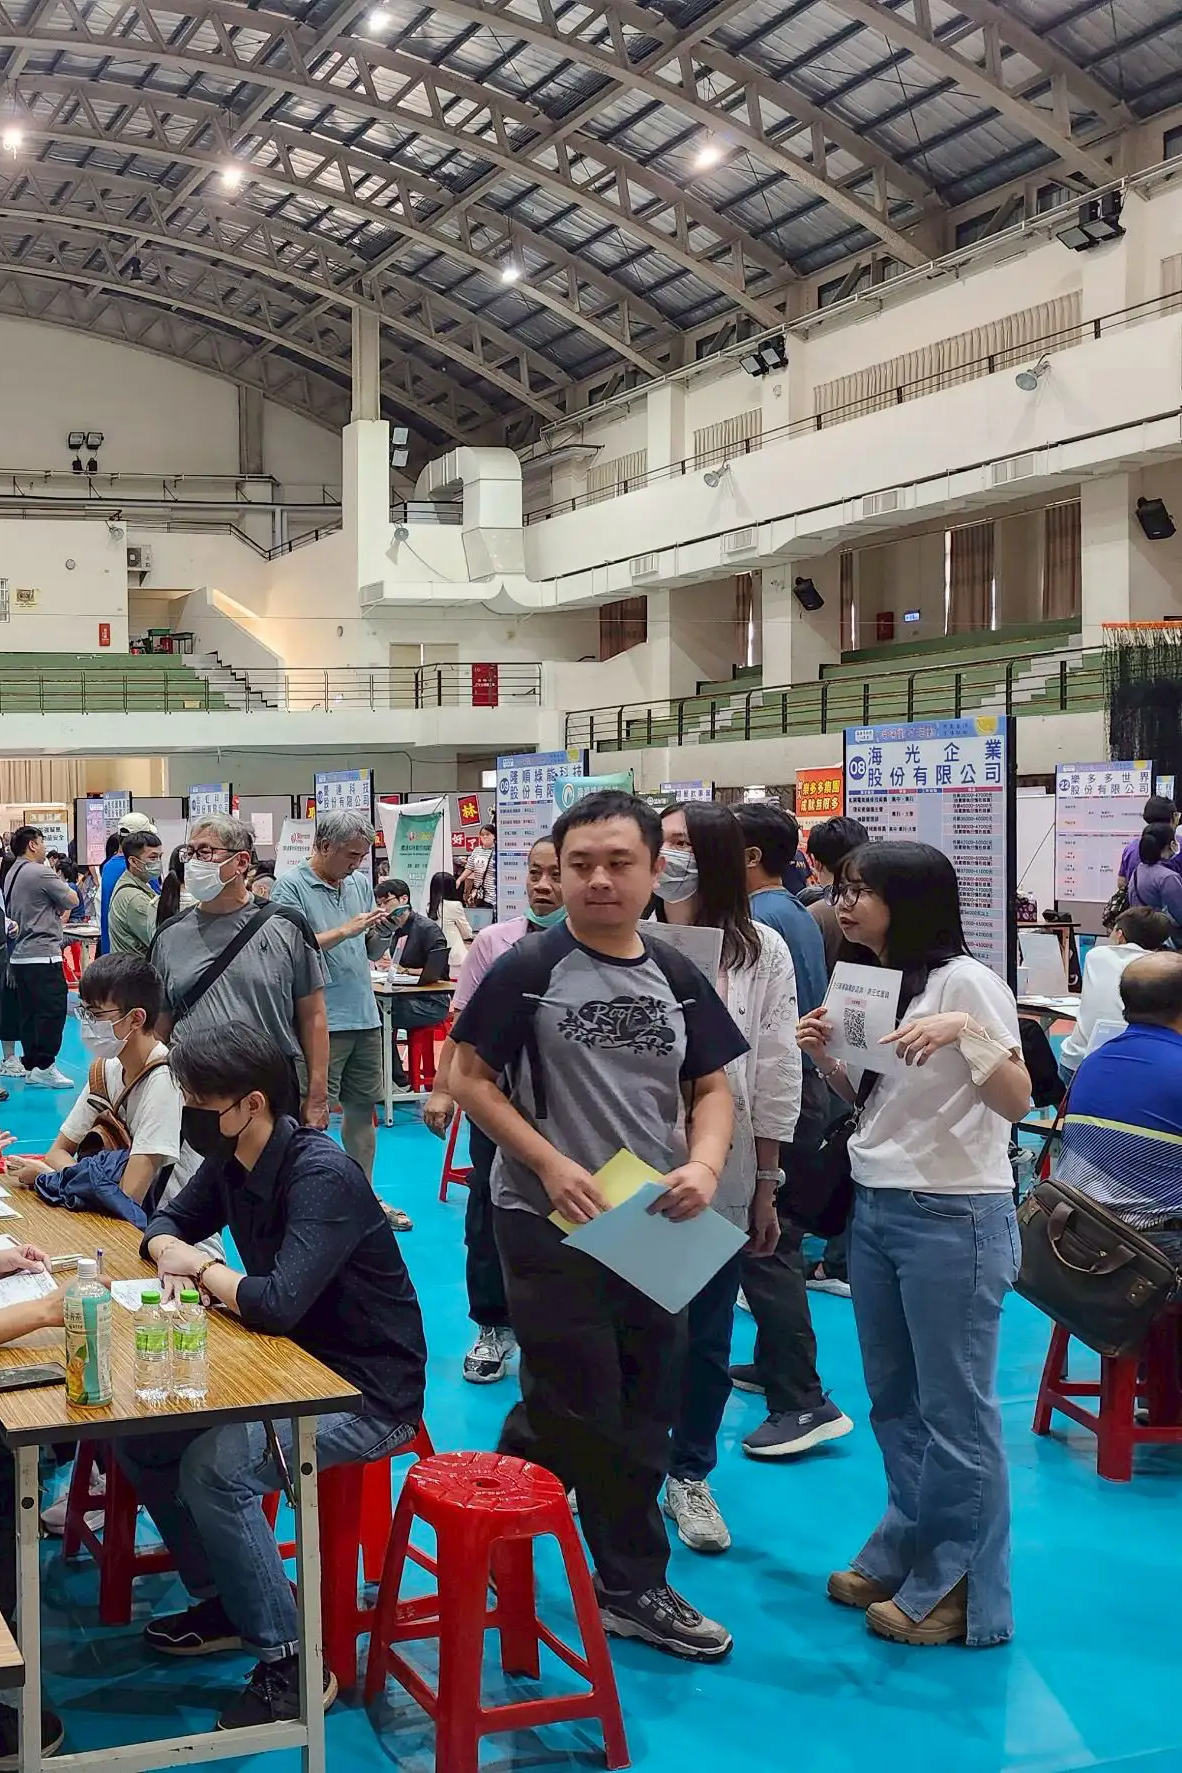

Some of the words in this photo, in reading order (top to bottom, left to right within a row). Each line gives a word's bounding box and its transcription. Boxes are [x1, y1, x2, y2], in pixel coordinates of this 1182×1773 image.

[868, 739, 1002, 766] 海光企業
[850, 762, 866, 775] 08
[868, 763, 1001, 787] 股份有限公司
[1071, 771, 1149, 784] 樂多多世界
[500, 782, 510, 792] 09
[1071, 783, 1149, 795] 股份有限公司
[324, 795, 369, 809] 股份有限公司
[462, 802, 478, 818] 林
[452, 833, 464, 846] 好
[590, 1003, 643, 1028] Roots
